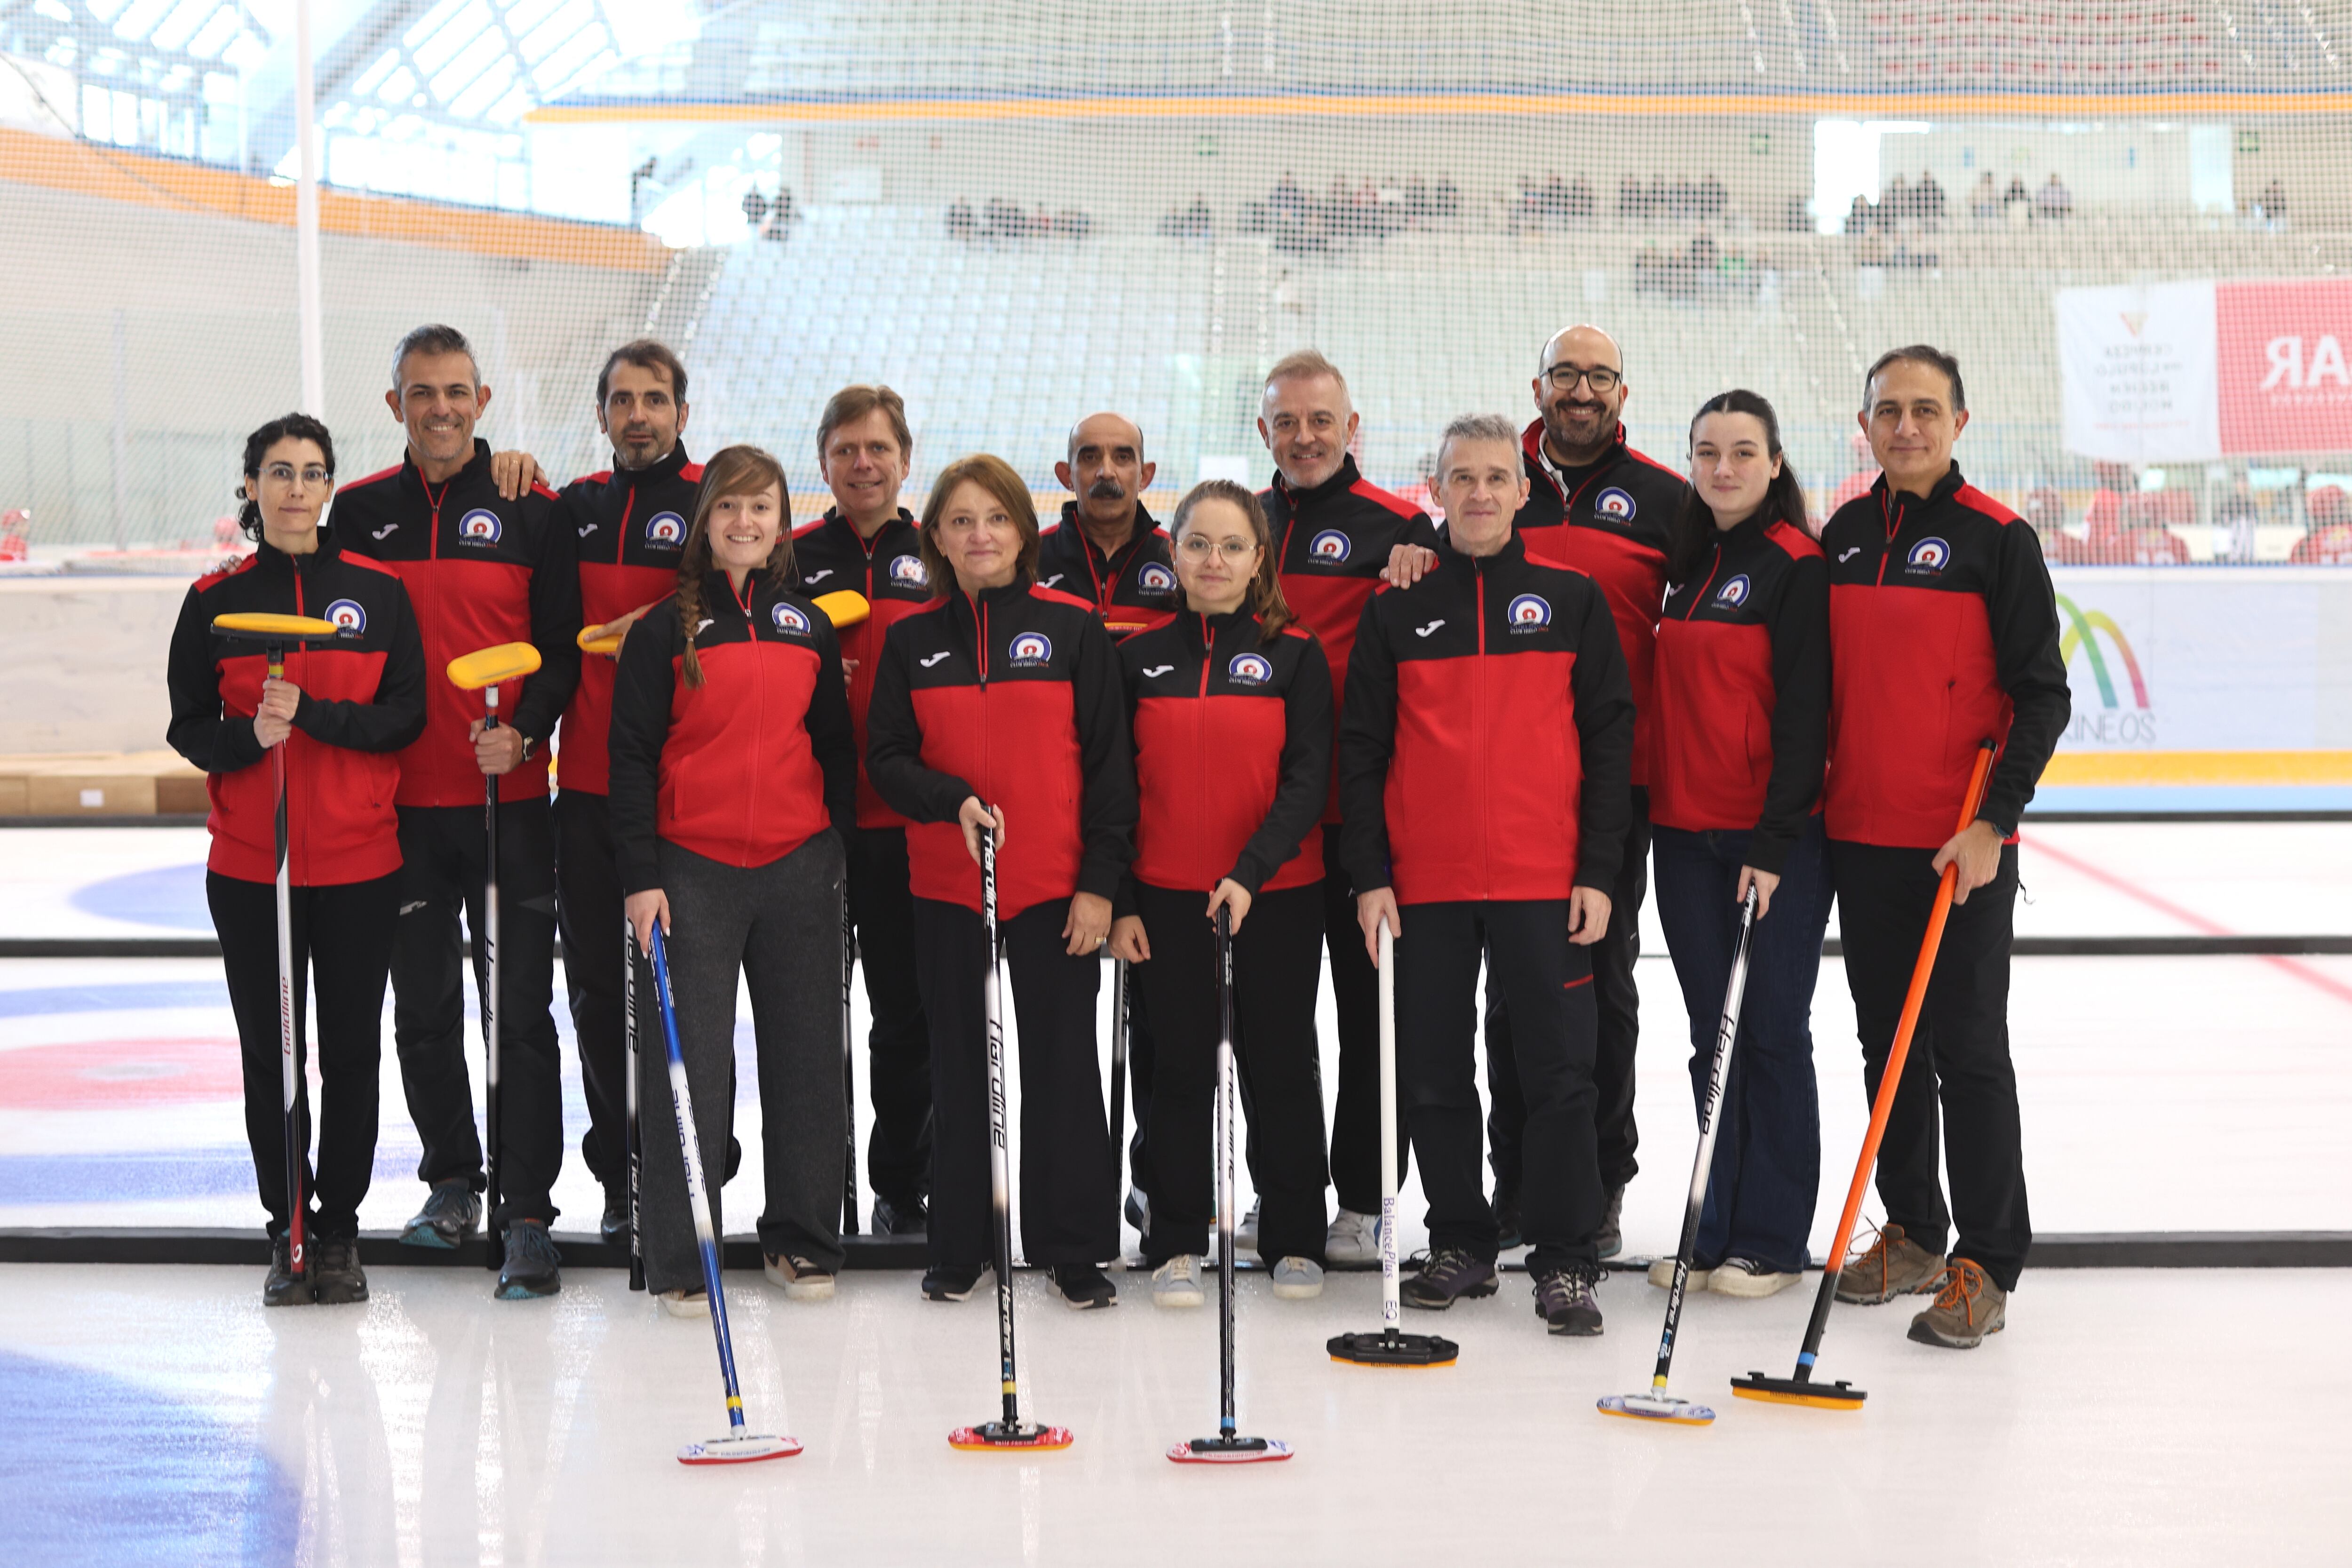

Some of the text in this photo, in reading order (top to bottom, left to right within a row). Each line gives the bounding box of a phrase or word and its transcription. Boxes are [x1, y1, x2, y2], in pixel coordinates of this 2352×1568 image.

[2064, 712, 2156, 744] INEOS
[985, 835, 996, 926] Hardline
[282, 976, 291, 1055] Goldline
[989, 1014, 1006, 1149] Hardline
[1702, 1013, 1734, 1136] Hardline
[1383, 1196, 1396, 1280] BalancePlus
[1002, 1283, 1011, 1355] Hardline
[1385, 1300, 1397, 1321] EQ
[1668, 1259, 1687, 1326] Hardline
